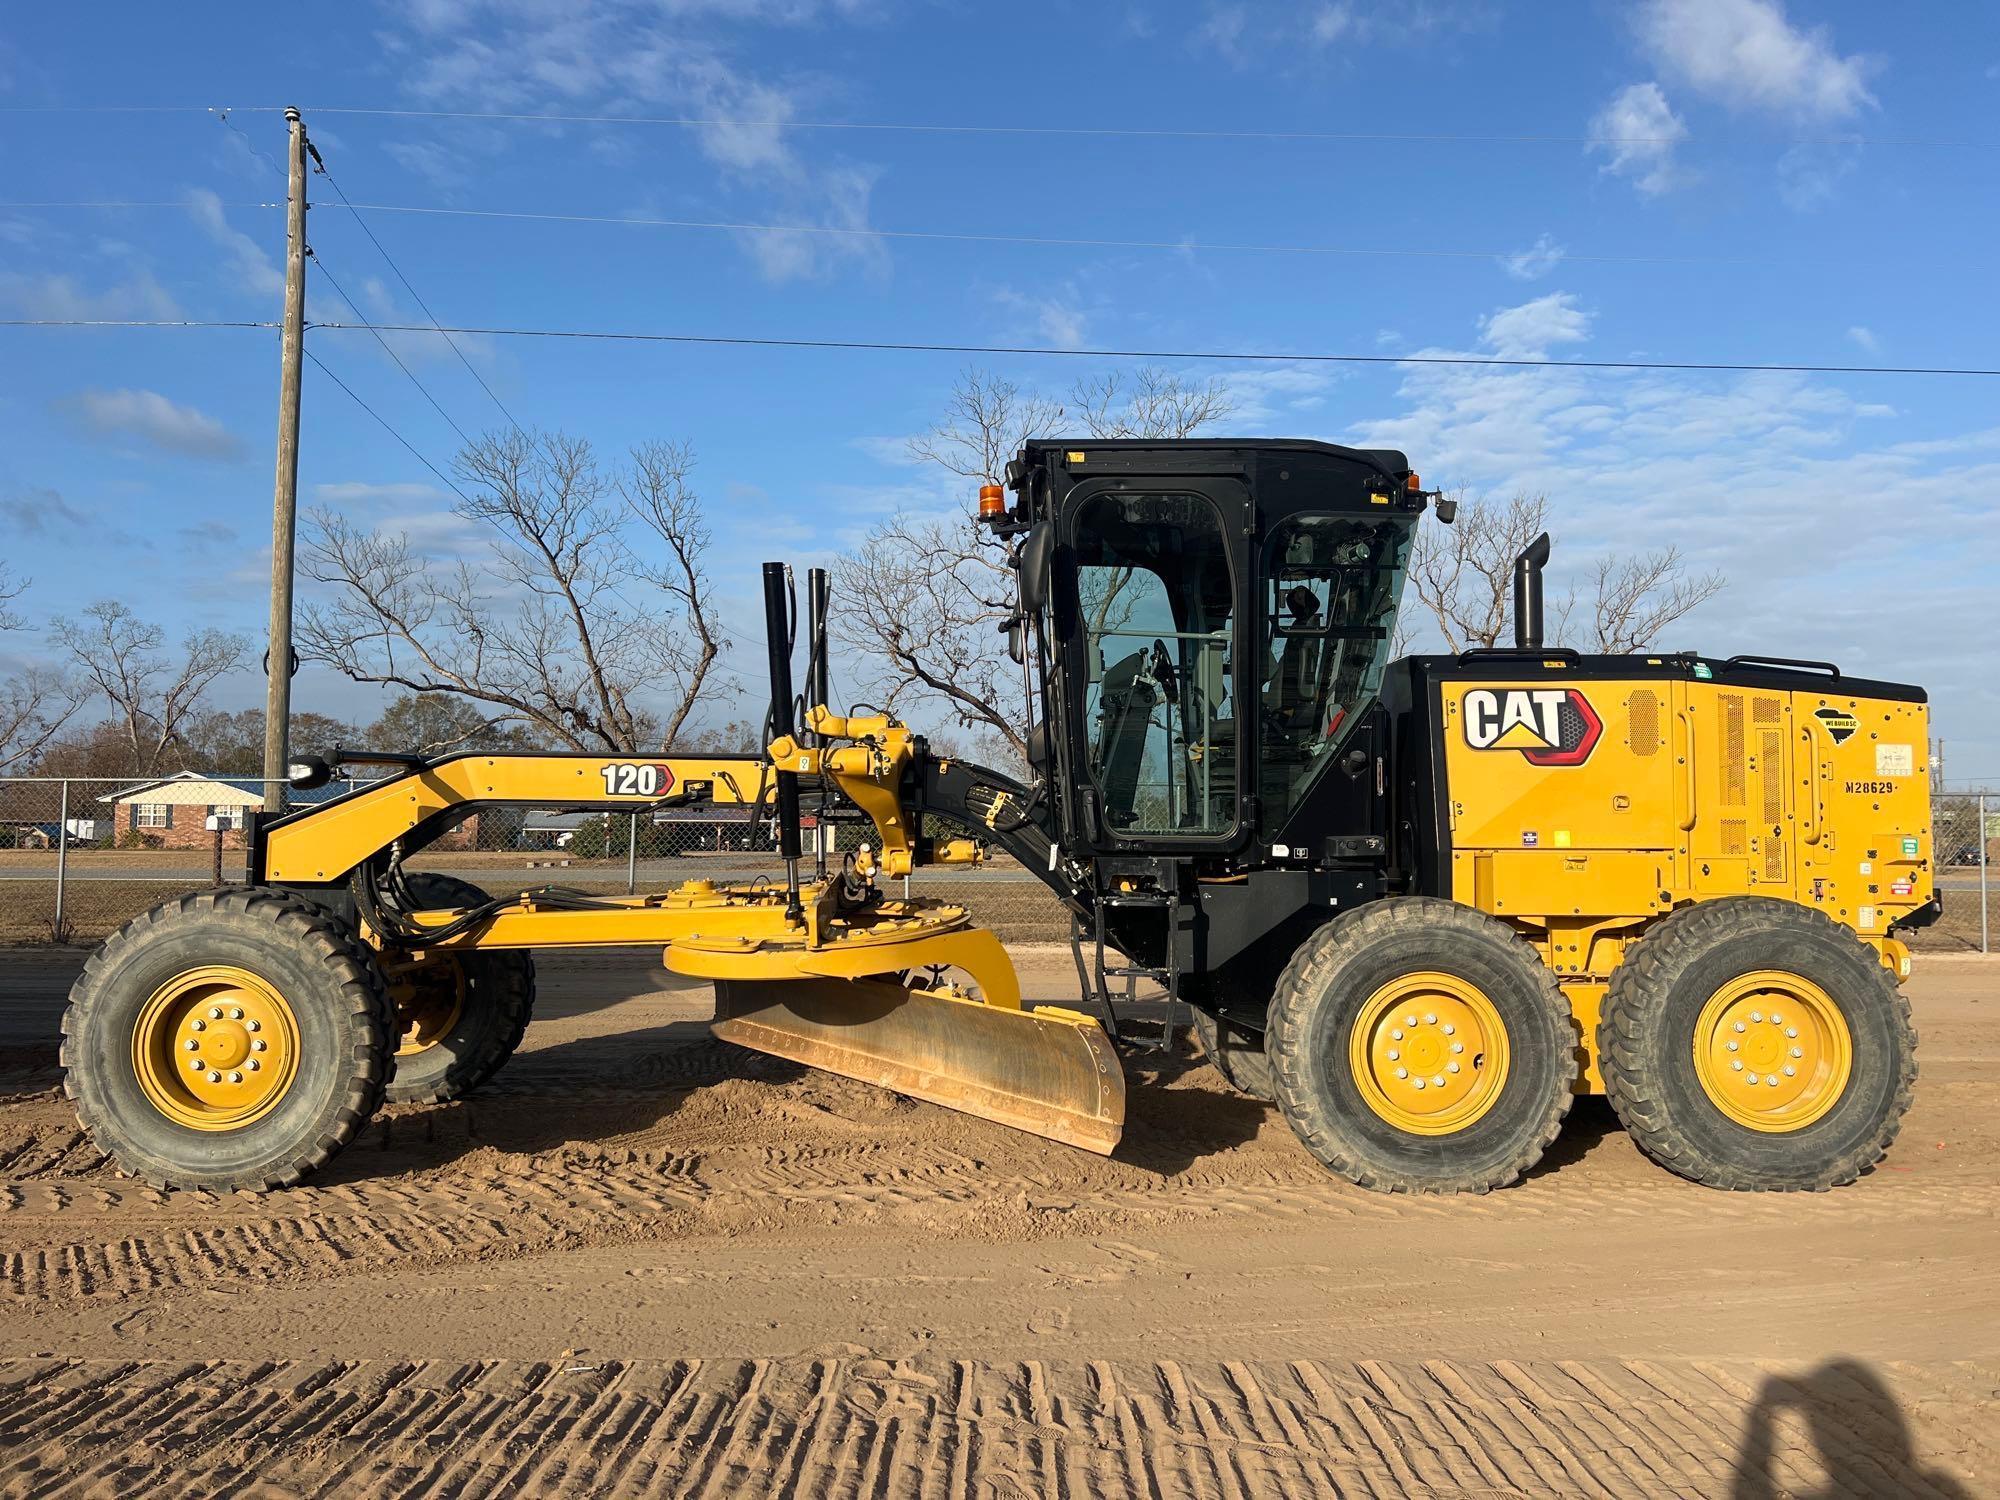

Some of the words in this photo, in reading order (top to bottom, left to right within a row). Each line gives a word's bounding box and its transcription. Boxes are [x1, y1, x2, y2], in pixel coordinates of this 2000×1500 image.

[1464, 690, 1566, 748] CAT
[601, 764, 657, 795] 120
[1845, 782, 1893, 794] M28629
